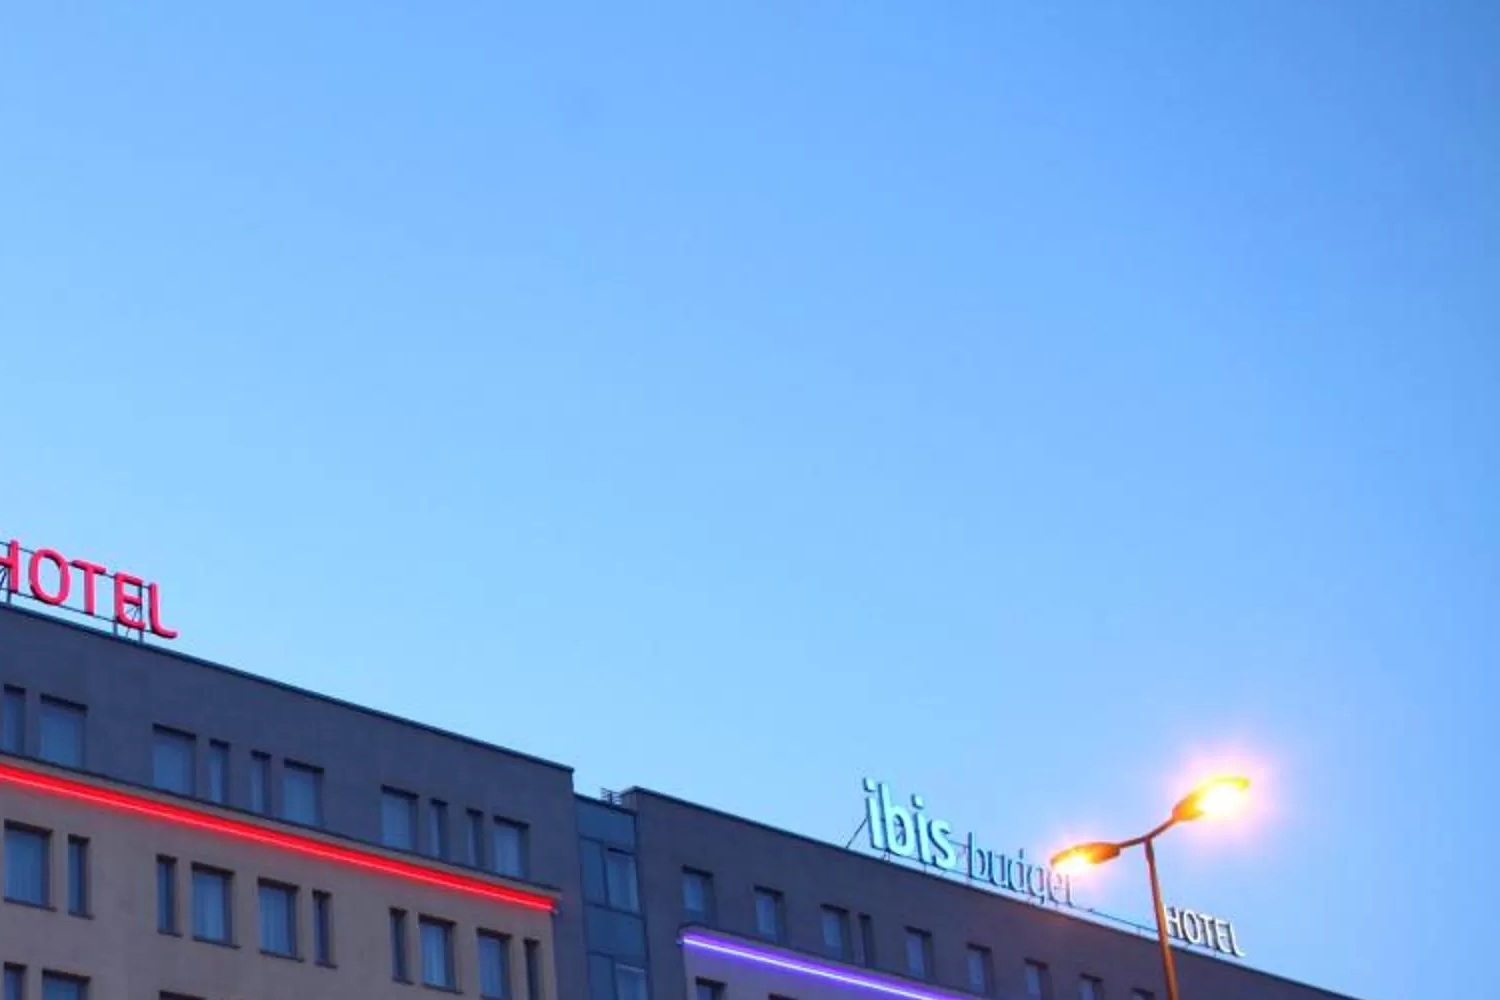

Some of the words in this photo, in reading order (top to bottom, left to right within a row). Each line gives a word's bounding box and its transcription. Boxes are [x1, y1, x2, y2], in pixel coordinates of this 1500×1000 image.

[863, 777, 957, 870] ibis
[966, 831, 1077, 907] budget
[1163, 903, 1246, 957] HOTEL
